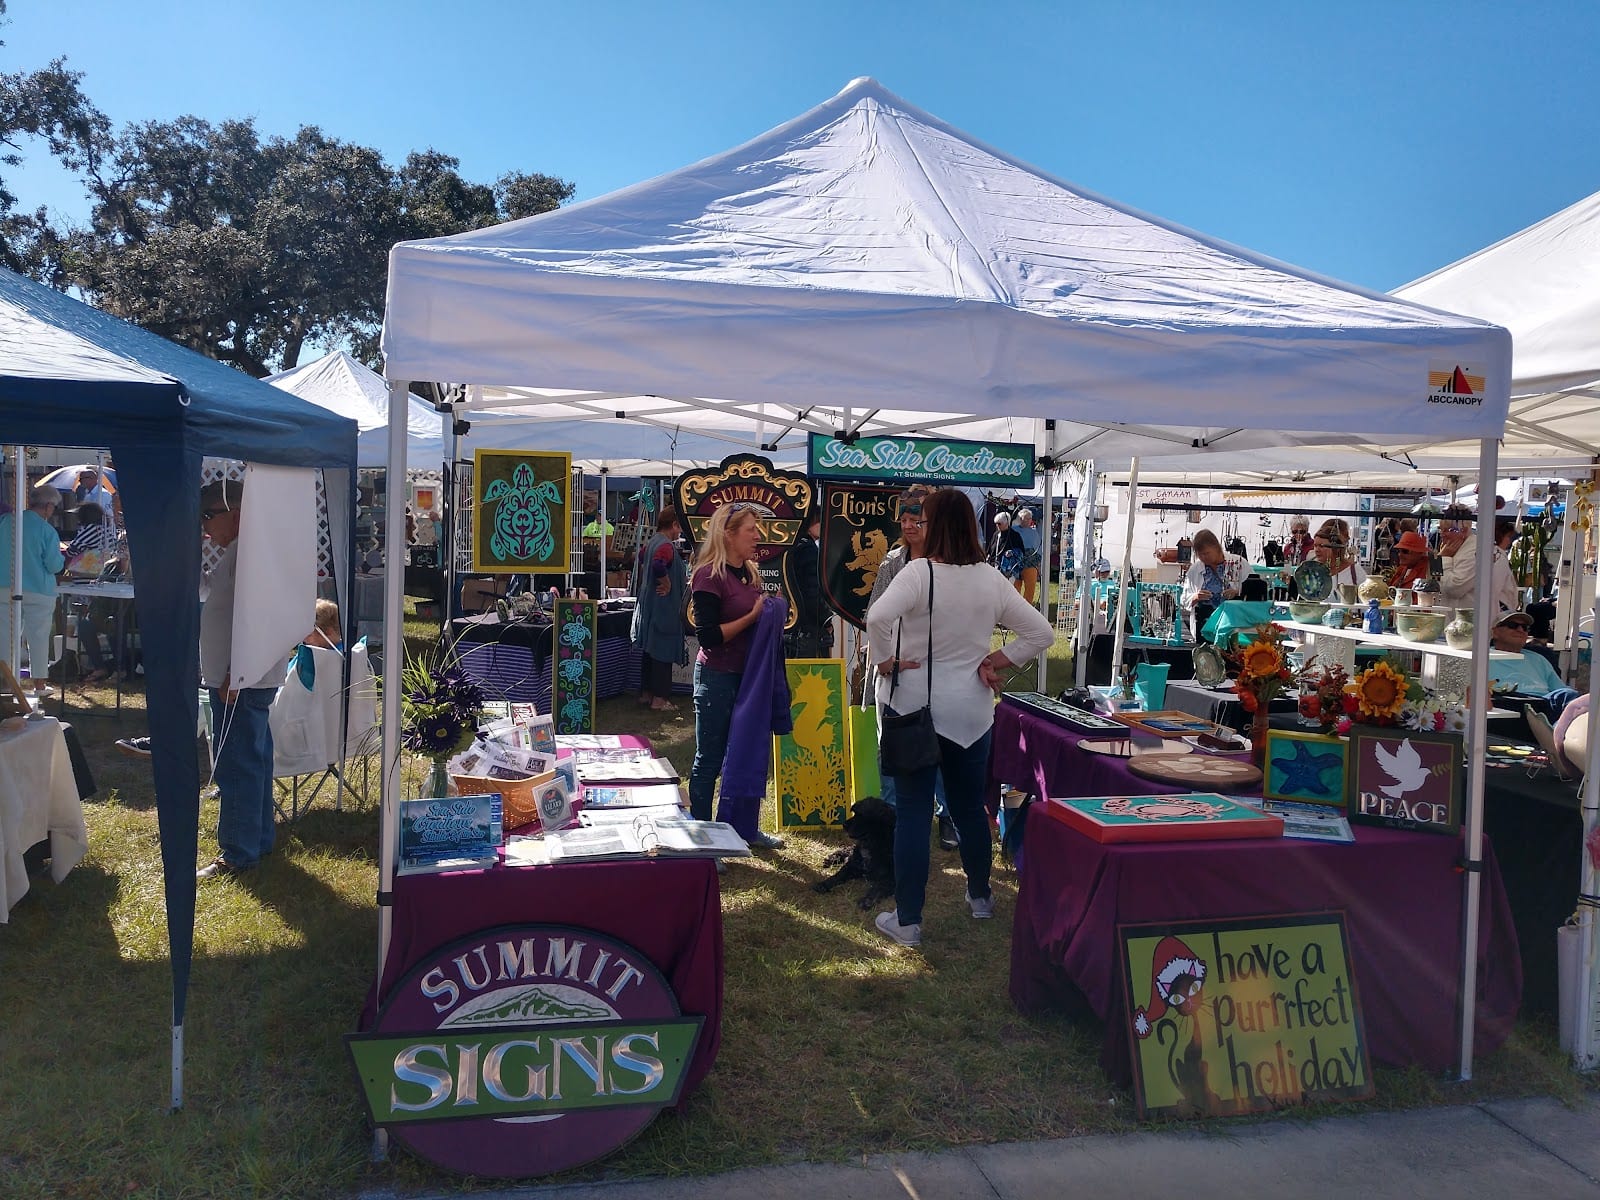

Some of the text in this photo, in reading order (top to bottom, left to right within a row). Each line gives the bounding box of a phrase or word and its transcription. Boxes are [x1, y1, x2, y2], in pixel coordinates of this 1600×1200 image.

[1427, 394, 1483, 406] ABCCANOPY
[819, 440, 1027, 477] Sea Side Creations
[904, 471, 932, 479] SUMMIT
[933, 472, 955, 480] SIGNS
[710, 485, 785, 509] SUMMIT
[831, 491, 886, 527] Lion's
[701, 520, 789, 543] SNS
[757, 569, 779, 577] ERING
[760, 582, 782, 591] SIGN
[1360, 791, 1448, 825] PEACE
[1213, 932, 1326, 983] have a
[420, 937, 645, 1014] SUMMIT
[1213, 976, 1350, 1048] purrrfect
[390, 1031, 664, 1113] SIGNS
[1225, 1034, 1359, 1100] holiday
